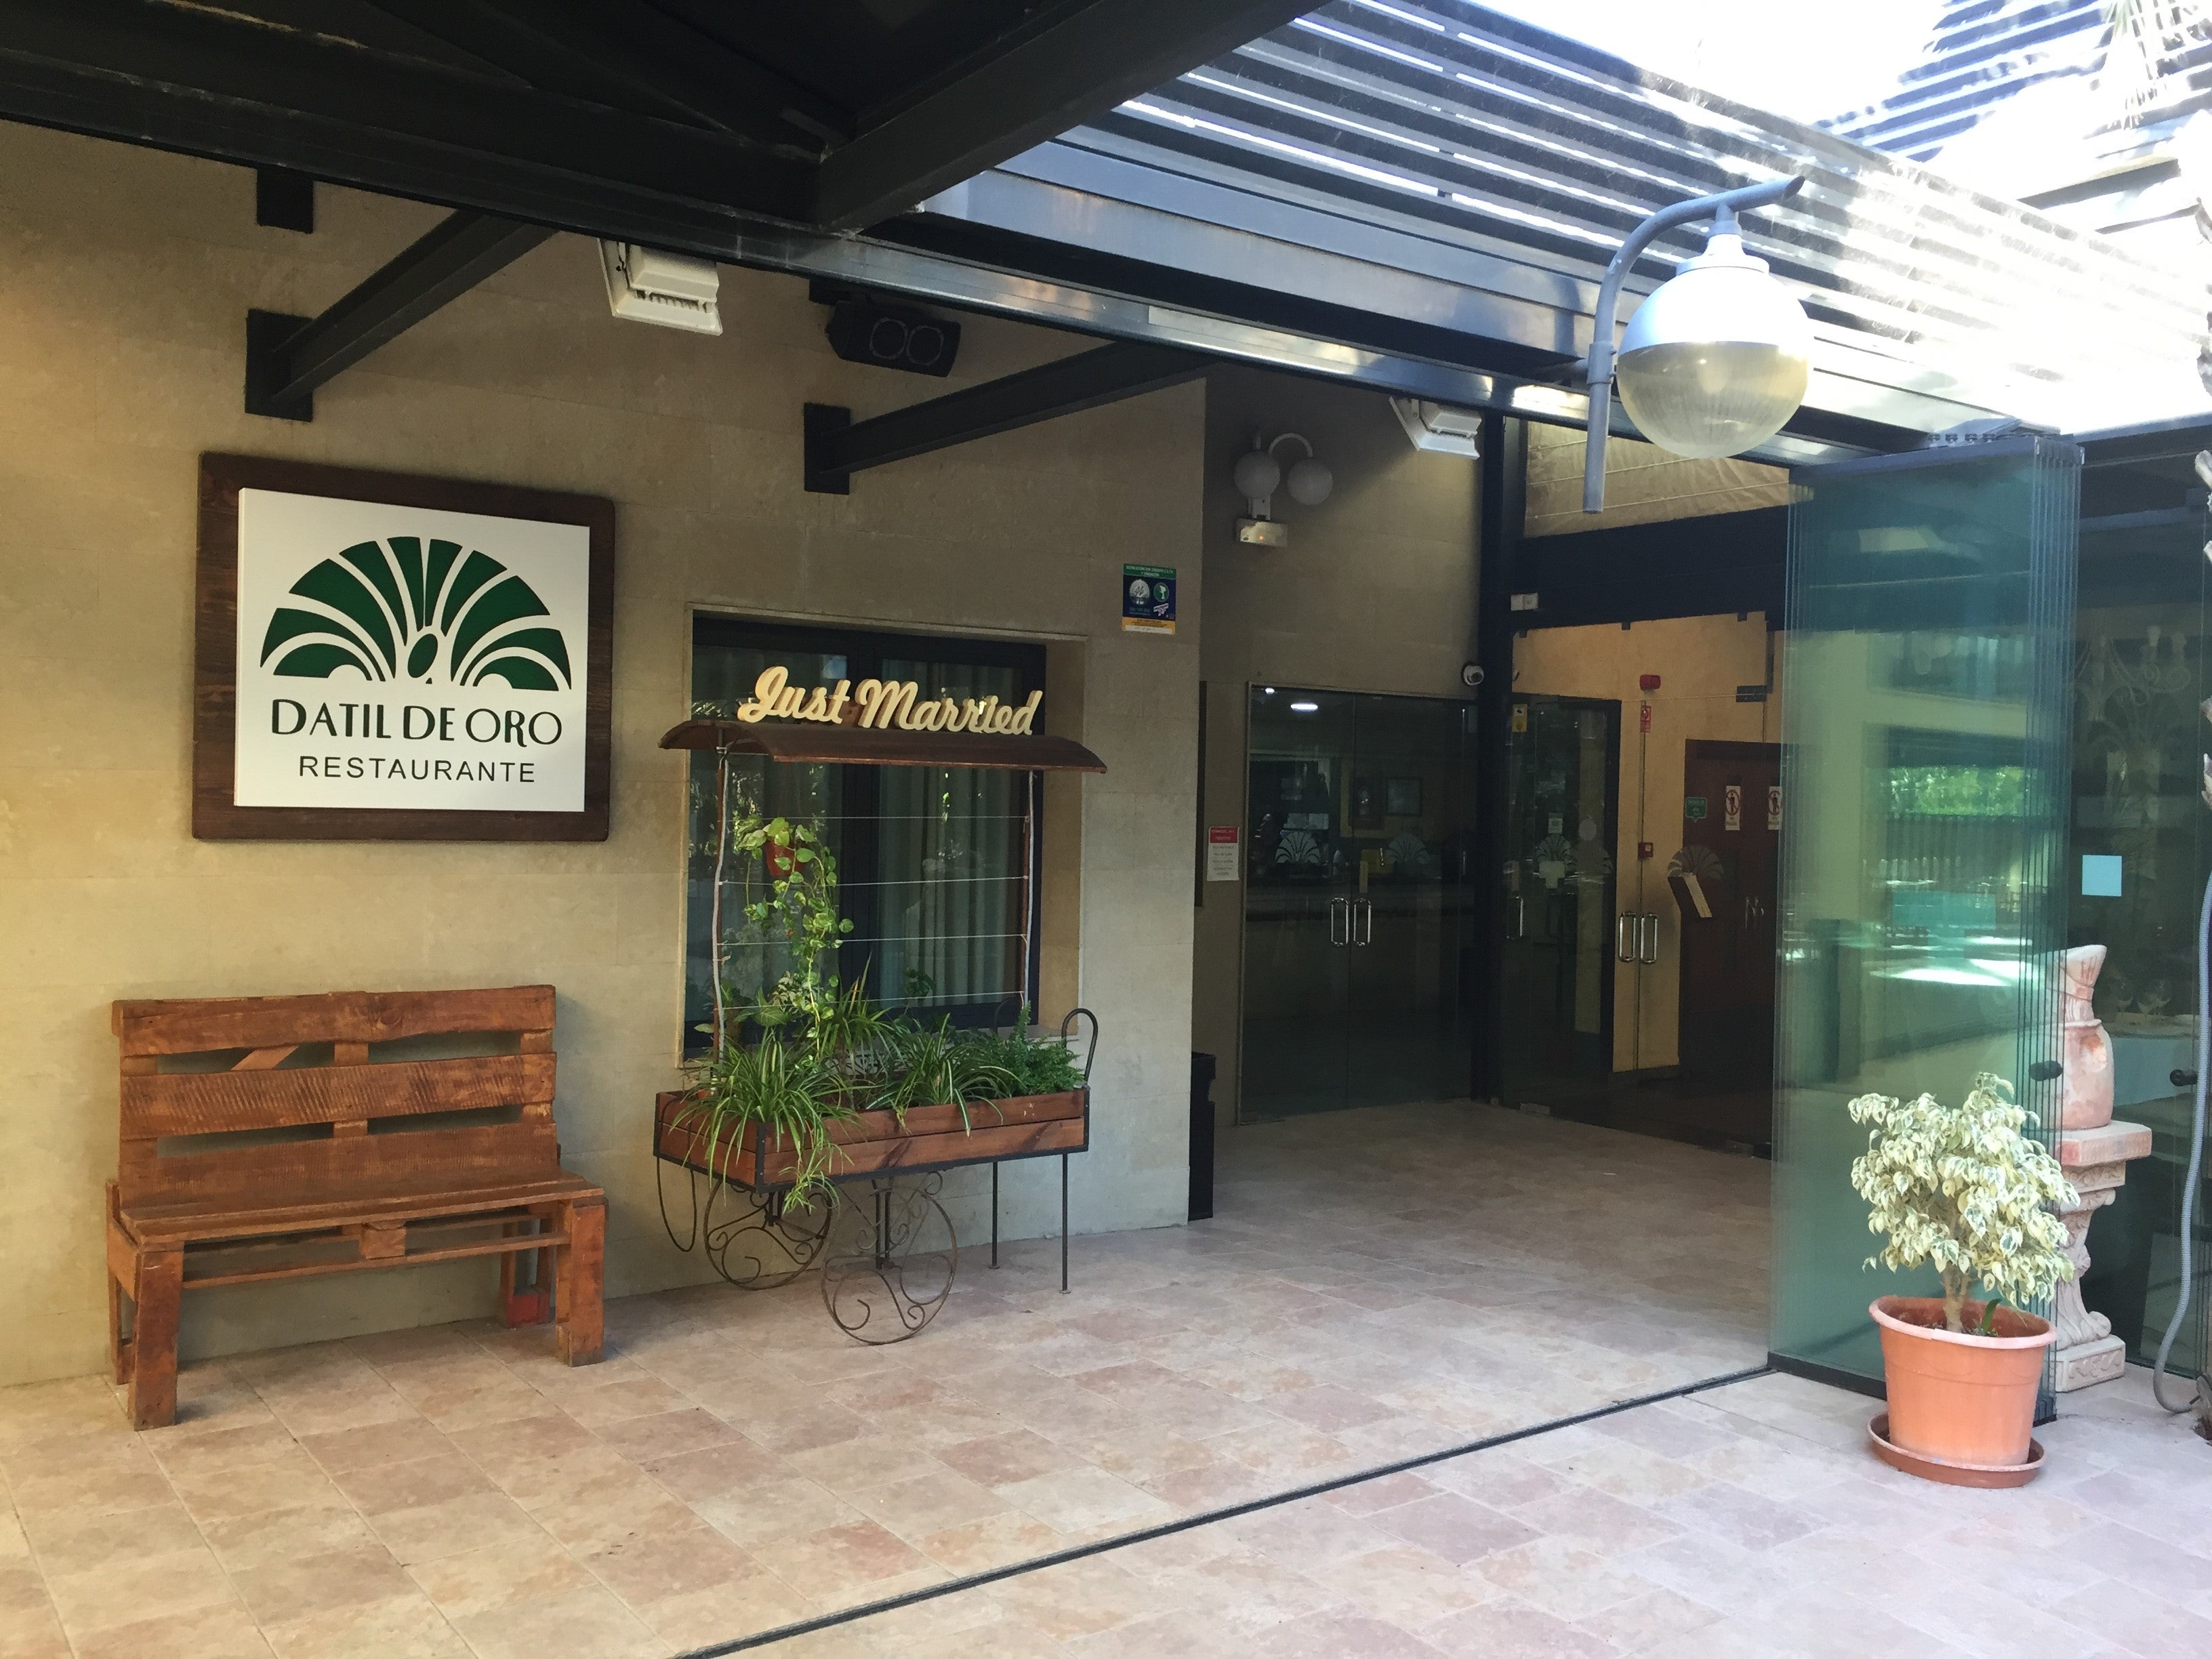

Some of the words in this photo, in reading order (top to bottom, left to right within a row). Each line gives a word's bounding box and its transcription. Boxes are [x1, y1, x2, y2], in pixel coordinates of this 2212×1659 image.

[272, 699, 391, 739] DATIL
[402, 705, 456, 741] DE
[465, 708, 562, 747] ORO
[737, 665, 851, 724] Just
[855, 678, 1043, 735] Married
[300, 756, 535, 782] RESTAURANTE
